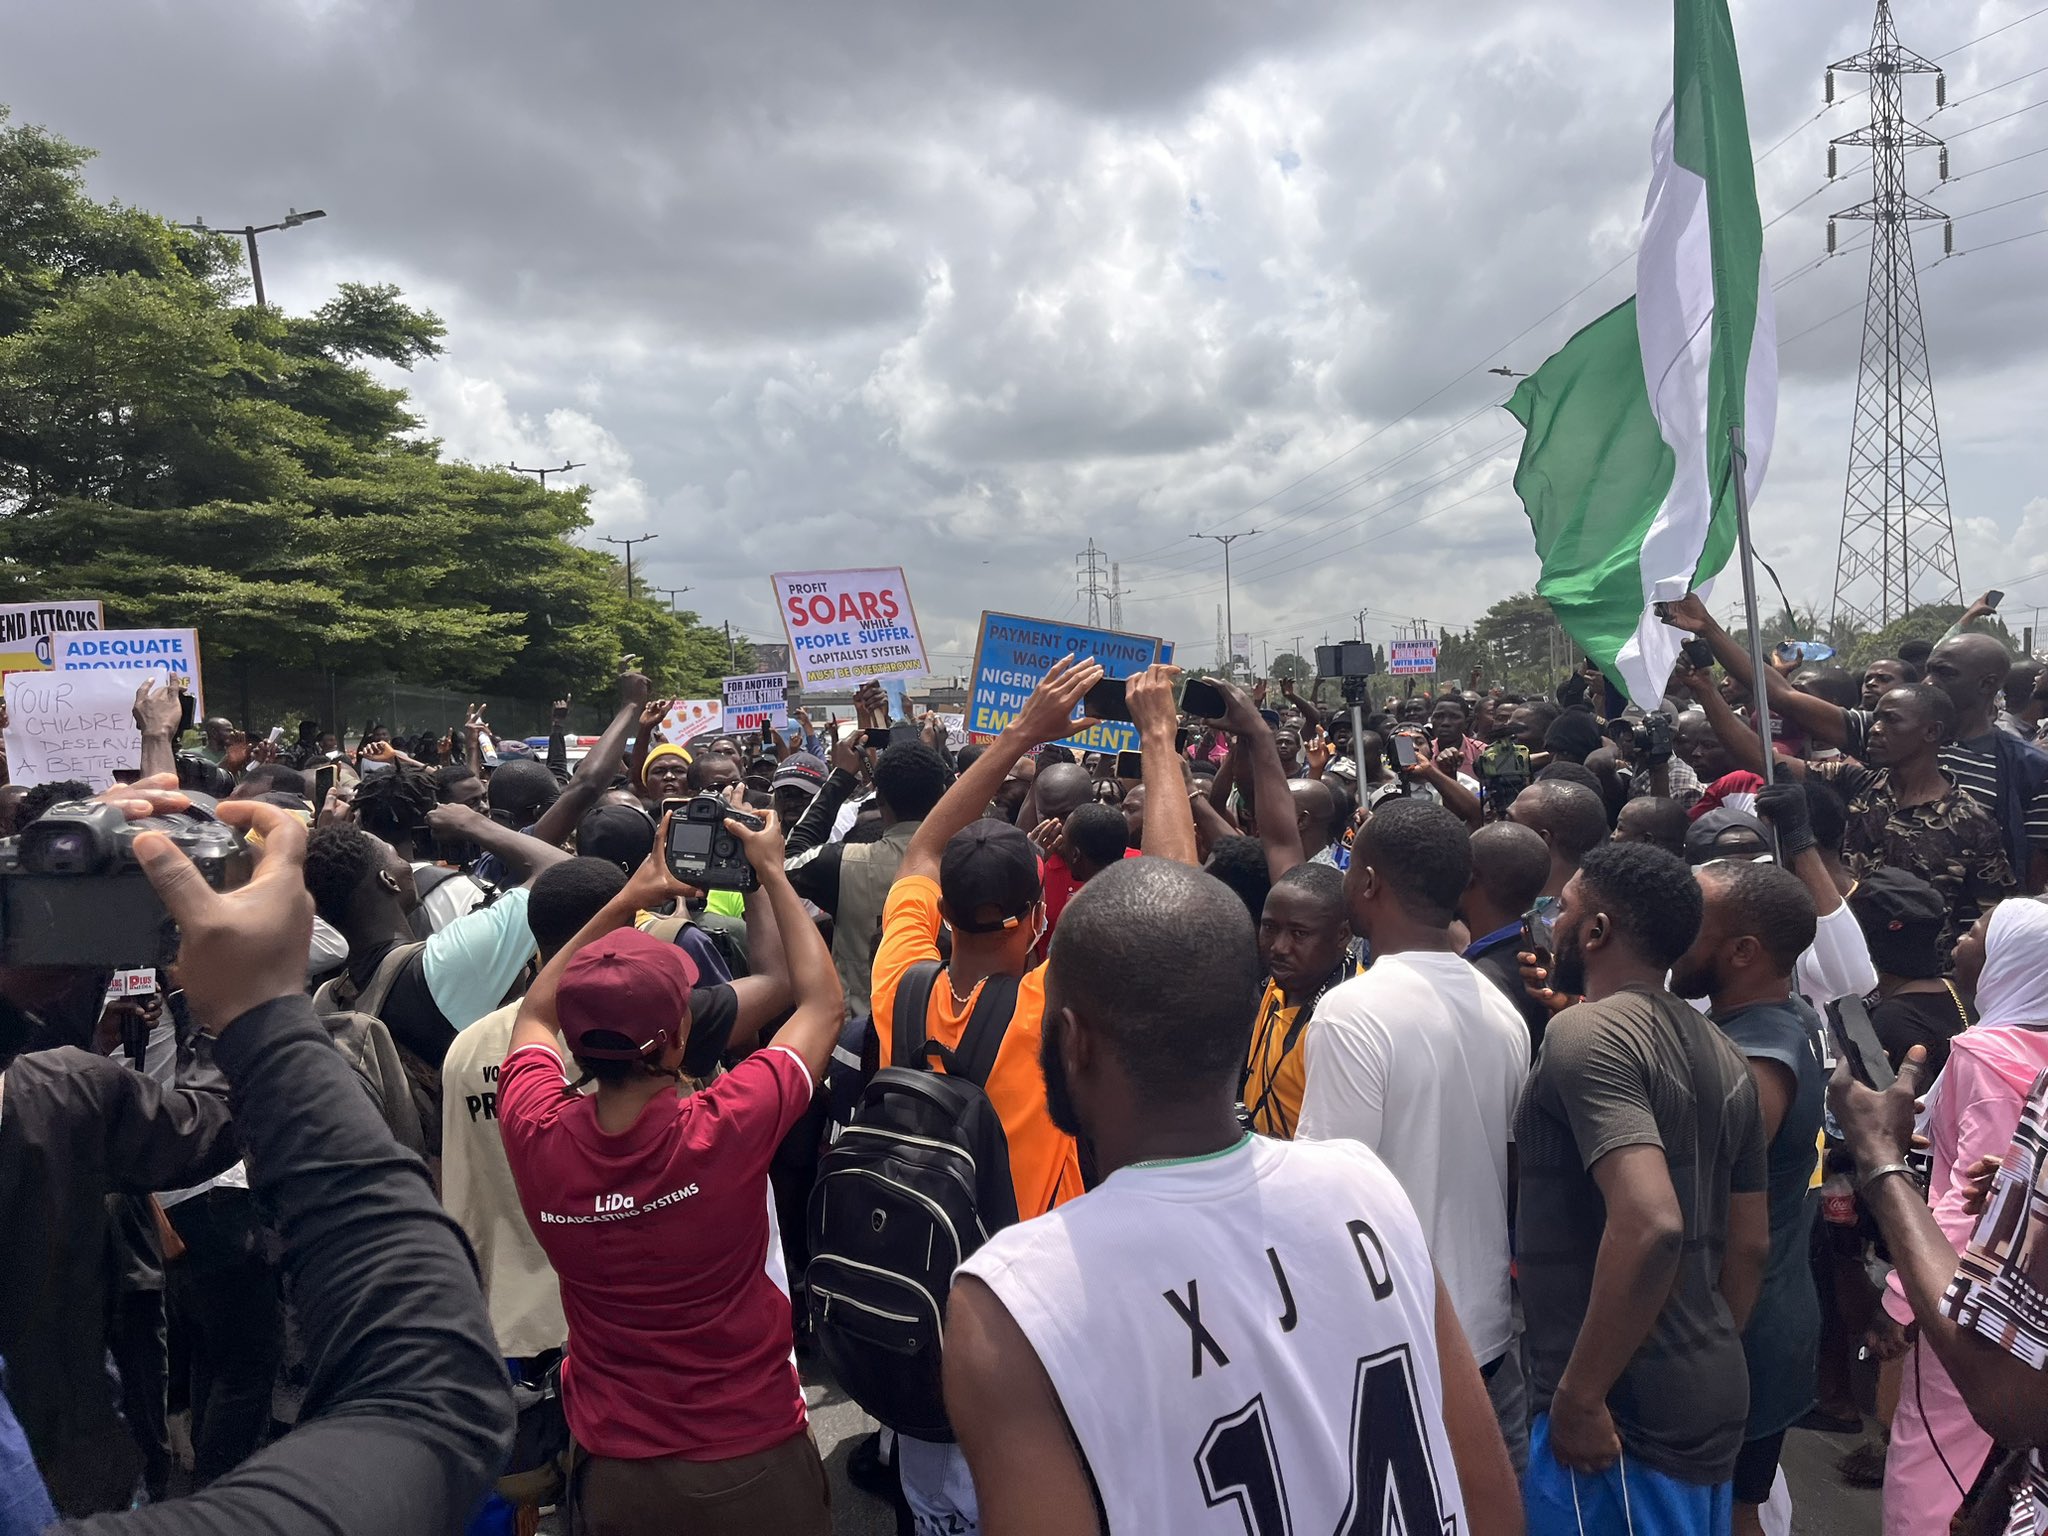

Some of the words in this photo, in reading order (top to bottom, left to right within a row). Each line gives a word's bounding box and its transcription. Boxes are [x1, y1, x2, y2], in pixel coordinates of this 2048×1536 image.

[788, 582, 828, 595] PROFIT
[788, 589, 899, 627] SOARS
[0, 612, 27, 643] END
[31, 609, 99, 637] ATTACKS
[860, 618, 894, 630] WHILE
[66, 638, 183, 656] ADEQUATE
[795, 631, 851, 650] PEOPLE
[859, 626, 915, 644] SUFFER.
[989, 624, 1063, 650] PAYMENT
[1066, 636, 1088, 654] OF
[1092, 640, 1148, 662] LIVING
[1407, 641, 1434, 649] ANOTHER
[809, 648, 869, 665] CAPITALIST
[871, 644, 911, 658] SYSTEM
[1394, 659, 1412, 667] WITH
[1413, 658, 1434, 666] MASS
[807, 668, 835, 682] MUST
[837, 666, 851, 678] BE
[852, 658, 922, 677] OVERTHROWN
[1392, 666, 1417, 674] PROTEST
[727, 682, 743, 692] FOR
[744, 677, 783, 691] ANOTHER
[9, 681, 74, 714] YOUR
[727, 692, 758, 706] GENERAL
[758, 688, 784, 703] STRIKE
[976, 688, 996, 705] IN
[726, 706, 742, 714] WITH
[743, 704, 760, 713] MASS
[760, 702, 786, 711] PROTEST
[40, 736, 142, 753] DESERVE
[16, 758, 37, 776] A
[47, 754, 133, 773] BETTER
[540, 1208, 640, 1225] BROADCASTING
[642, 1182, 700, 1212] SYSTEMS
[595, 1193, 634, 1213] LiDa
[1193, 1342, 1460, 1536] 14
